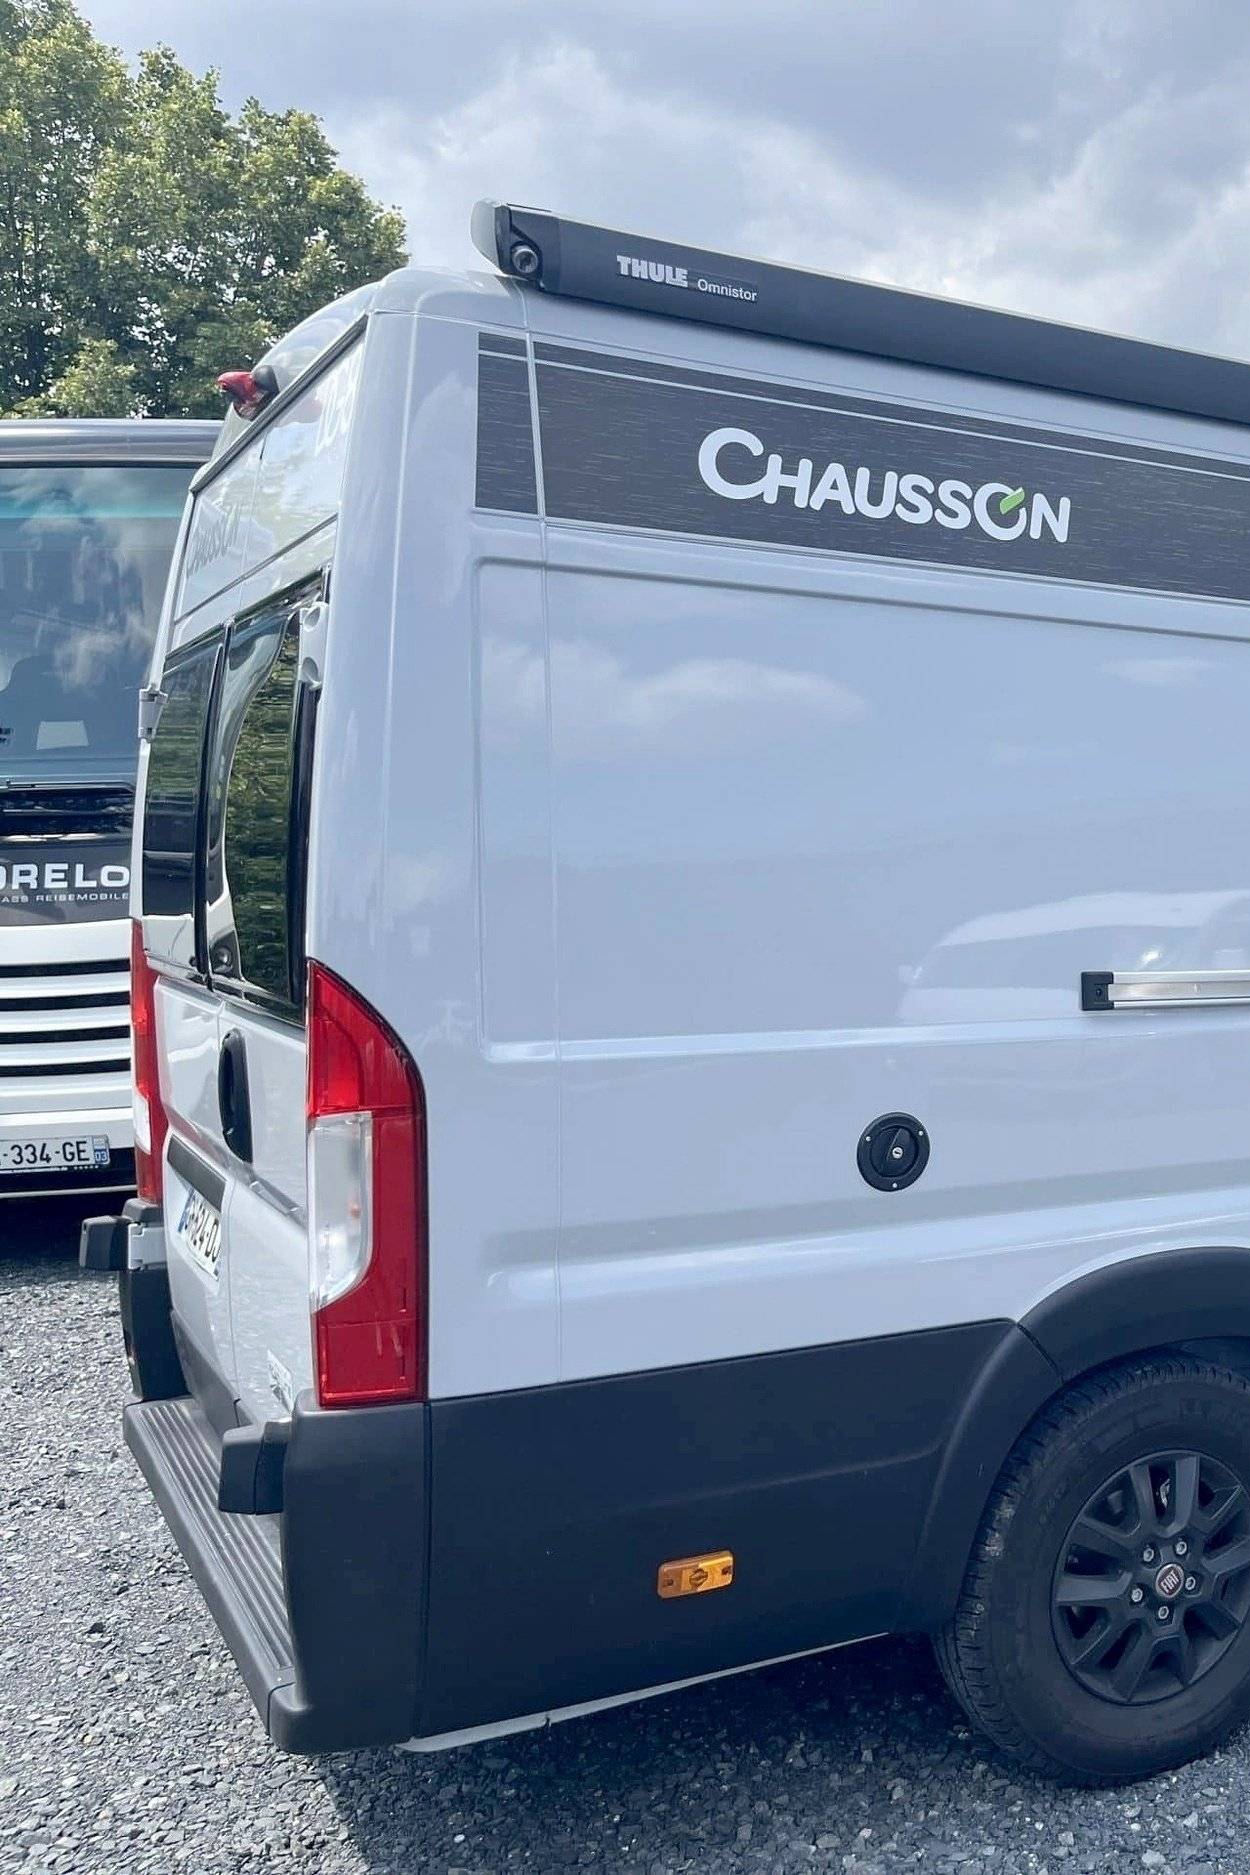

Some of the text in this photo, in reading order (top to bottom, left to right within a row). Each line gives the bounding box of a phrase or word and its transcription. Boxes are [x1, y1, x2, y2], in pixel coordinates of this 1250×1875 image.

[616, 255, 757, 301] THULE Omnistor
[698, 427, 1071, 542] CHAUSSON
[0, 863, 130, 890] RELO
[1160, 1569, 1180, 1594] FIAT
